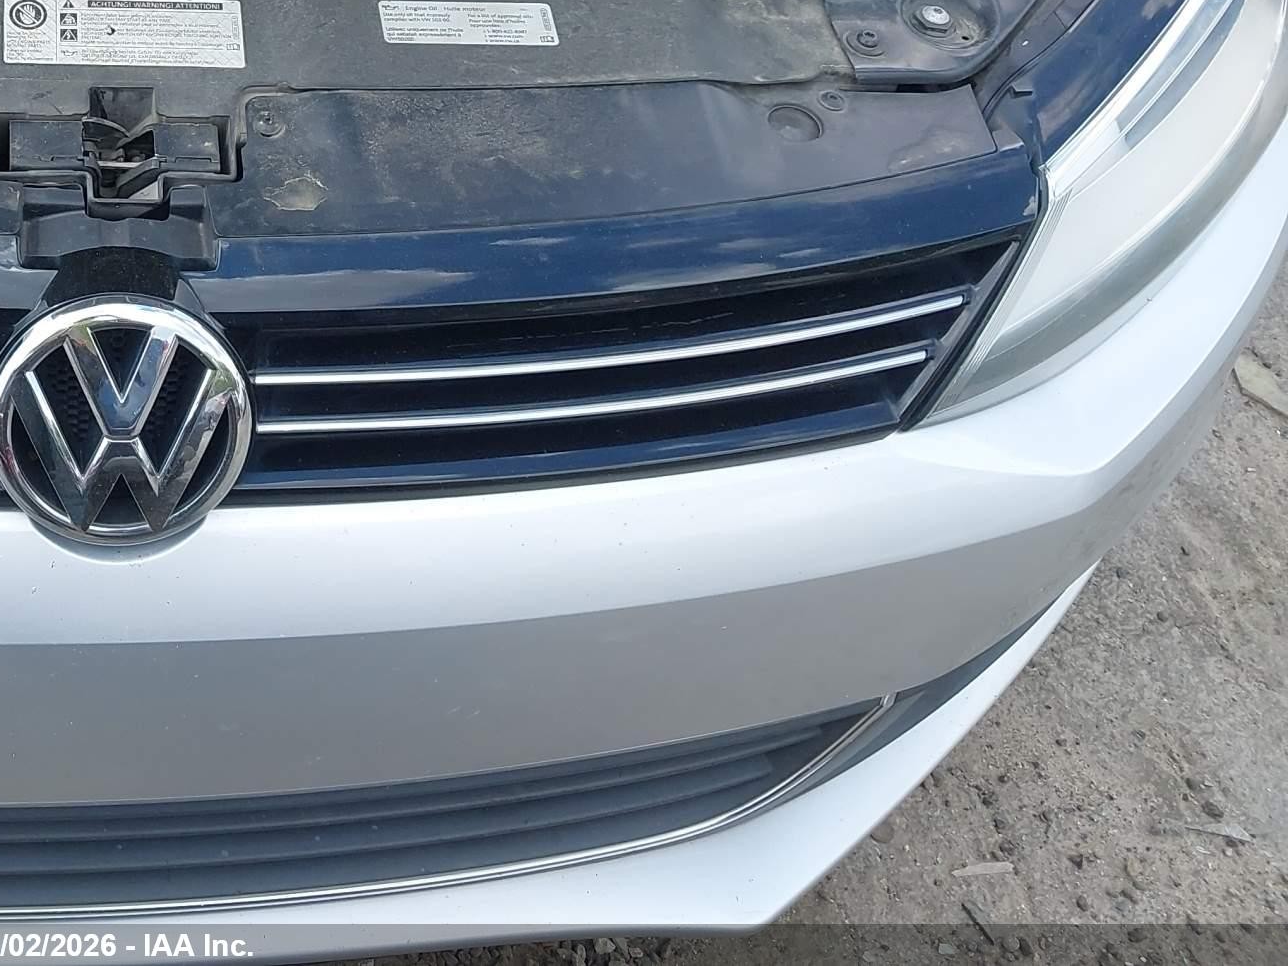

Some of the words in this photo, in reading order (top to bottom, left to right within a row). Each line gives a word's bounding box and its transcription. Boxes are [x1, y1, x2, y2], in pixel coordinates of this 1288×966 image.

[90, 0, 131, 8] ACHTUNG!
[133, 1, 174, 10] WARNING!
[175, 2, 220, 11] ATTENTION!
